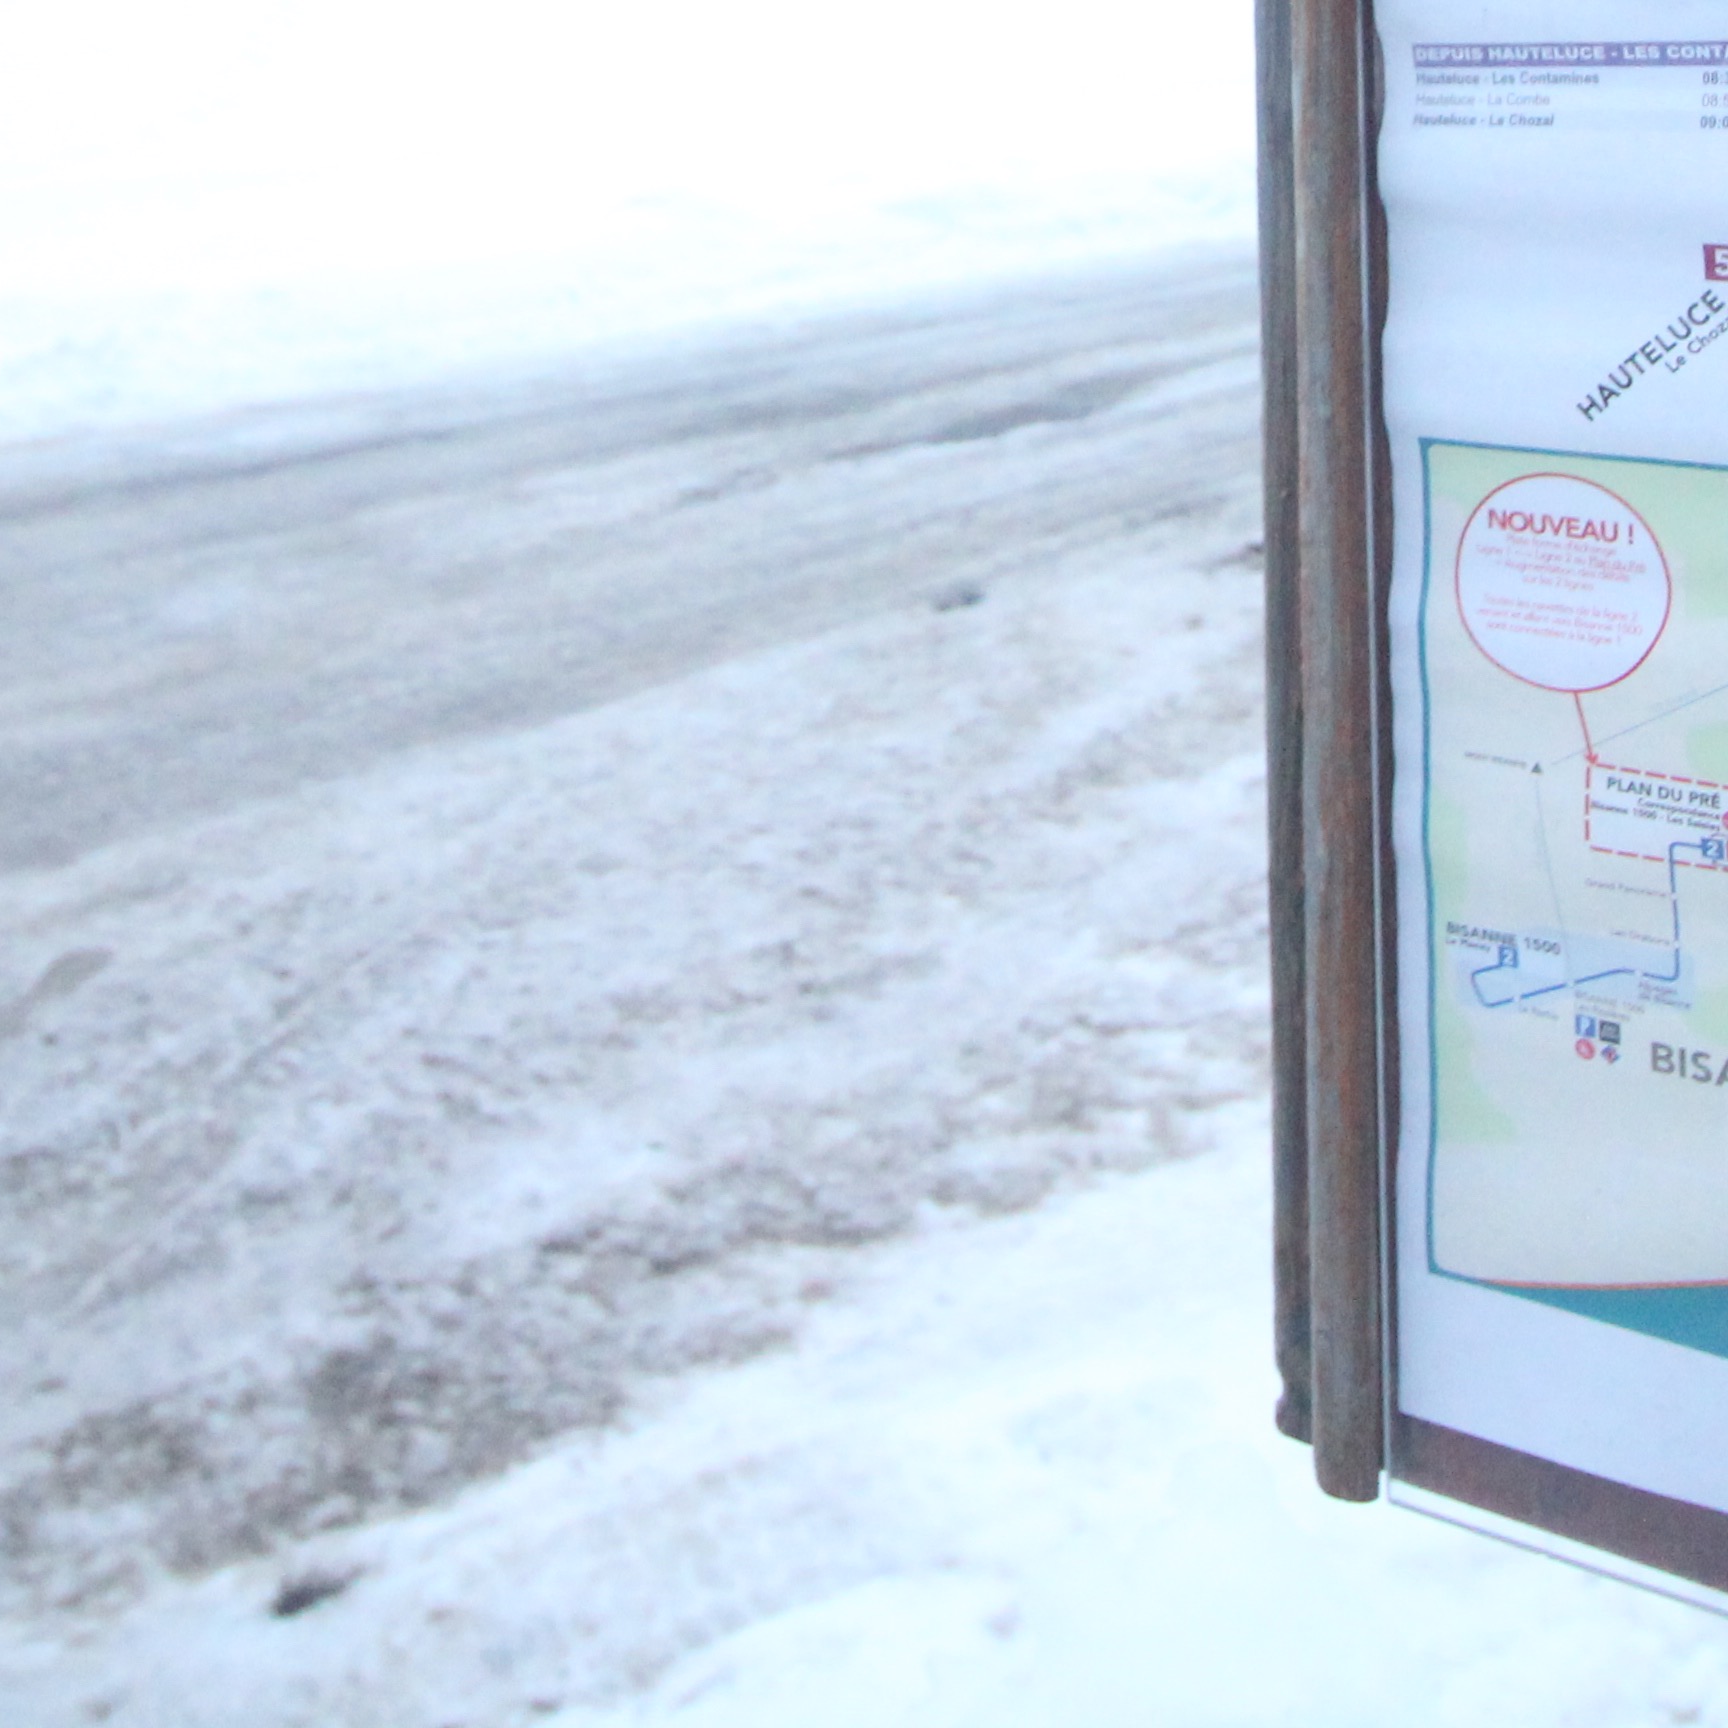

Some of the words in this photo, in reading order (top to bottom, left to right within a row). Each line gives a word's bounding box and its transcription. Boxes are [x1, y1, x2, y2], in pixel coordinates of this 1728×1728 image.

[1488, 46, 1605, 60] HAUTELUCE
[1622, 45, 1660, 60] LES
[1576, 289, 1726, 421] HAUTELUCE
[1487, 508, 1619, 542] NOUVEAU
[1606, 776, 1651, 799] PLAN
